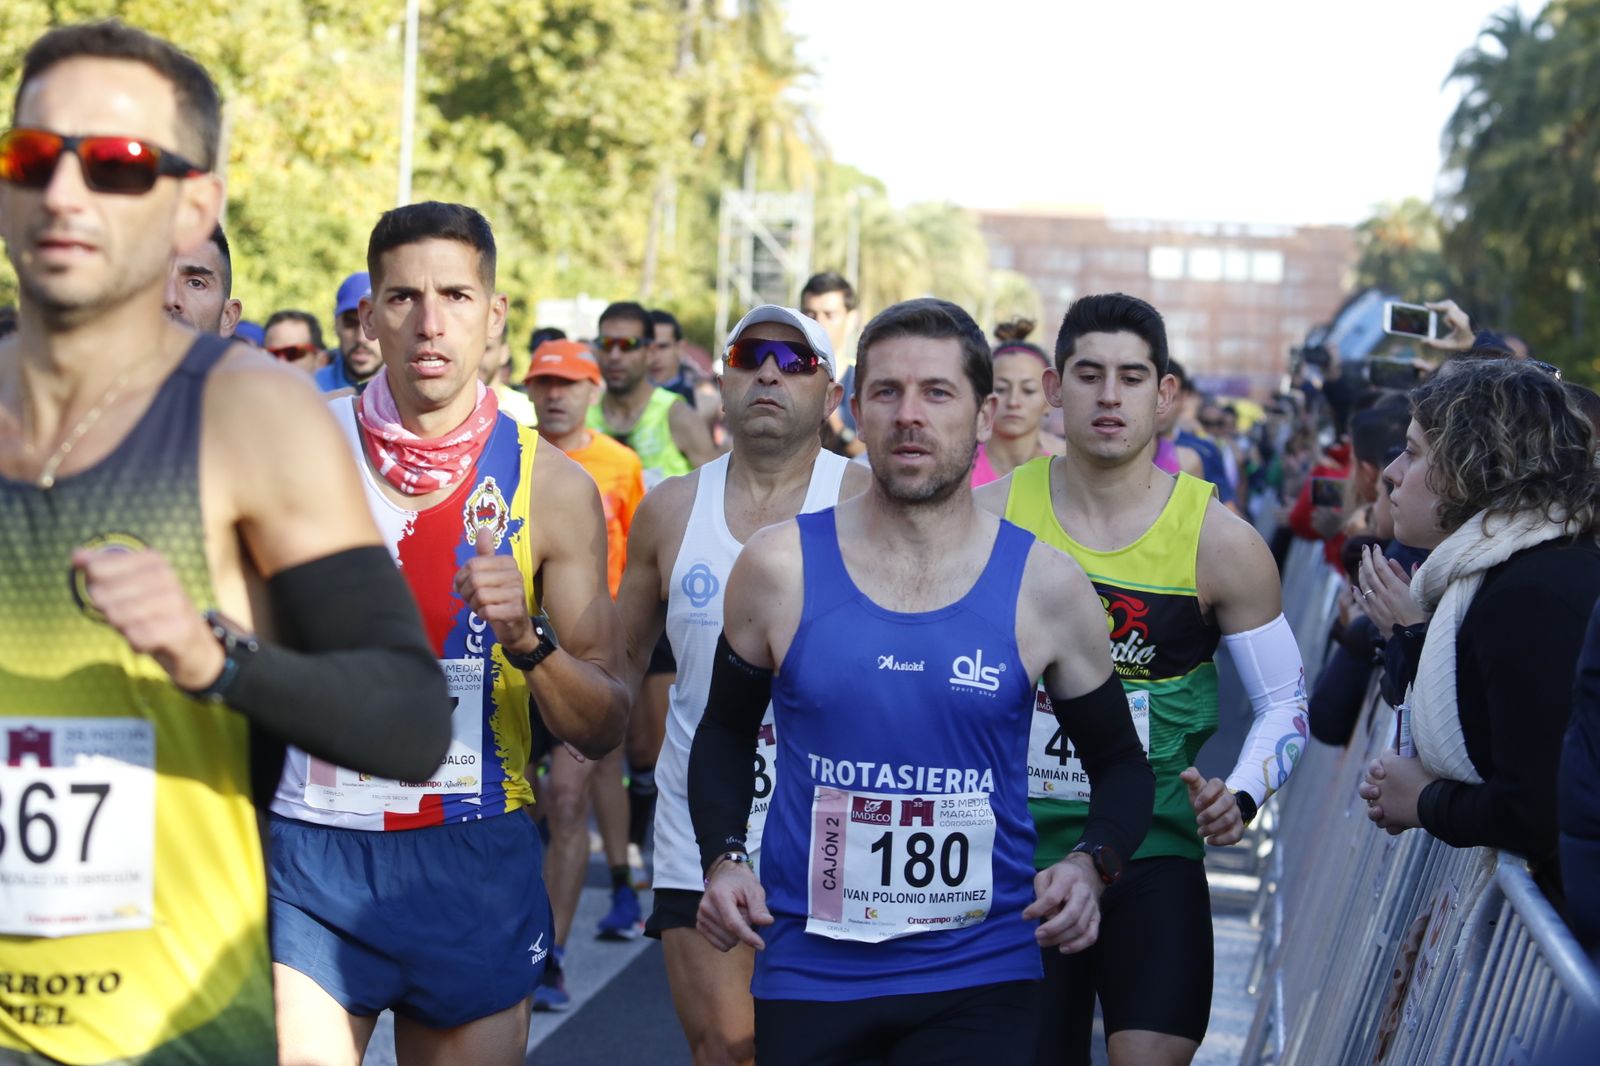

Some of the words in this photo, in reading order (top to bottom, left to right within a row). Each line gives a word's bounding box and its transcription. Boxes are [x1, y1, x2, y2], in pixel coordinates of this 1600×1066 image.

[1109, 629, 1157, 665] dic
[445, 664, 482, 673] MEDIA
[440, 755, 476, 766] DALGO
[807, 753, 995, 793] TROTASIERRA
[1027, 766, 1069, 782] DAMIÁN
[1071, 773, 1089, 784] RE
[941, 800, 955, 809] 35
[852, 811, 891, 824] IMDECO
[940, 807, 993, 819] MARATÓN
[0, 781, 111, 865] 67
[827, 817, 840, 827] 2
[822, 832, 839, 890] CAJÓN
[871, 831, 969, 888] 180
[843, 888, 871, 901] IVAN
[872, 891, 926, 904] POLONIO
[929, 889, 987, 904] MARTINEZ
[907, 916, 950, 925] Cruzcampo
